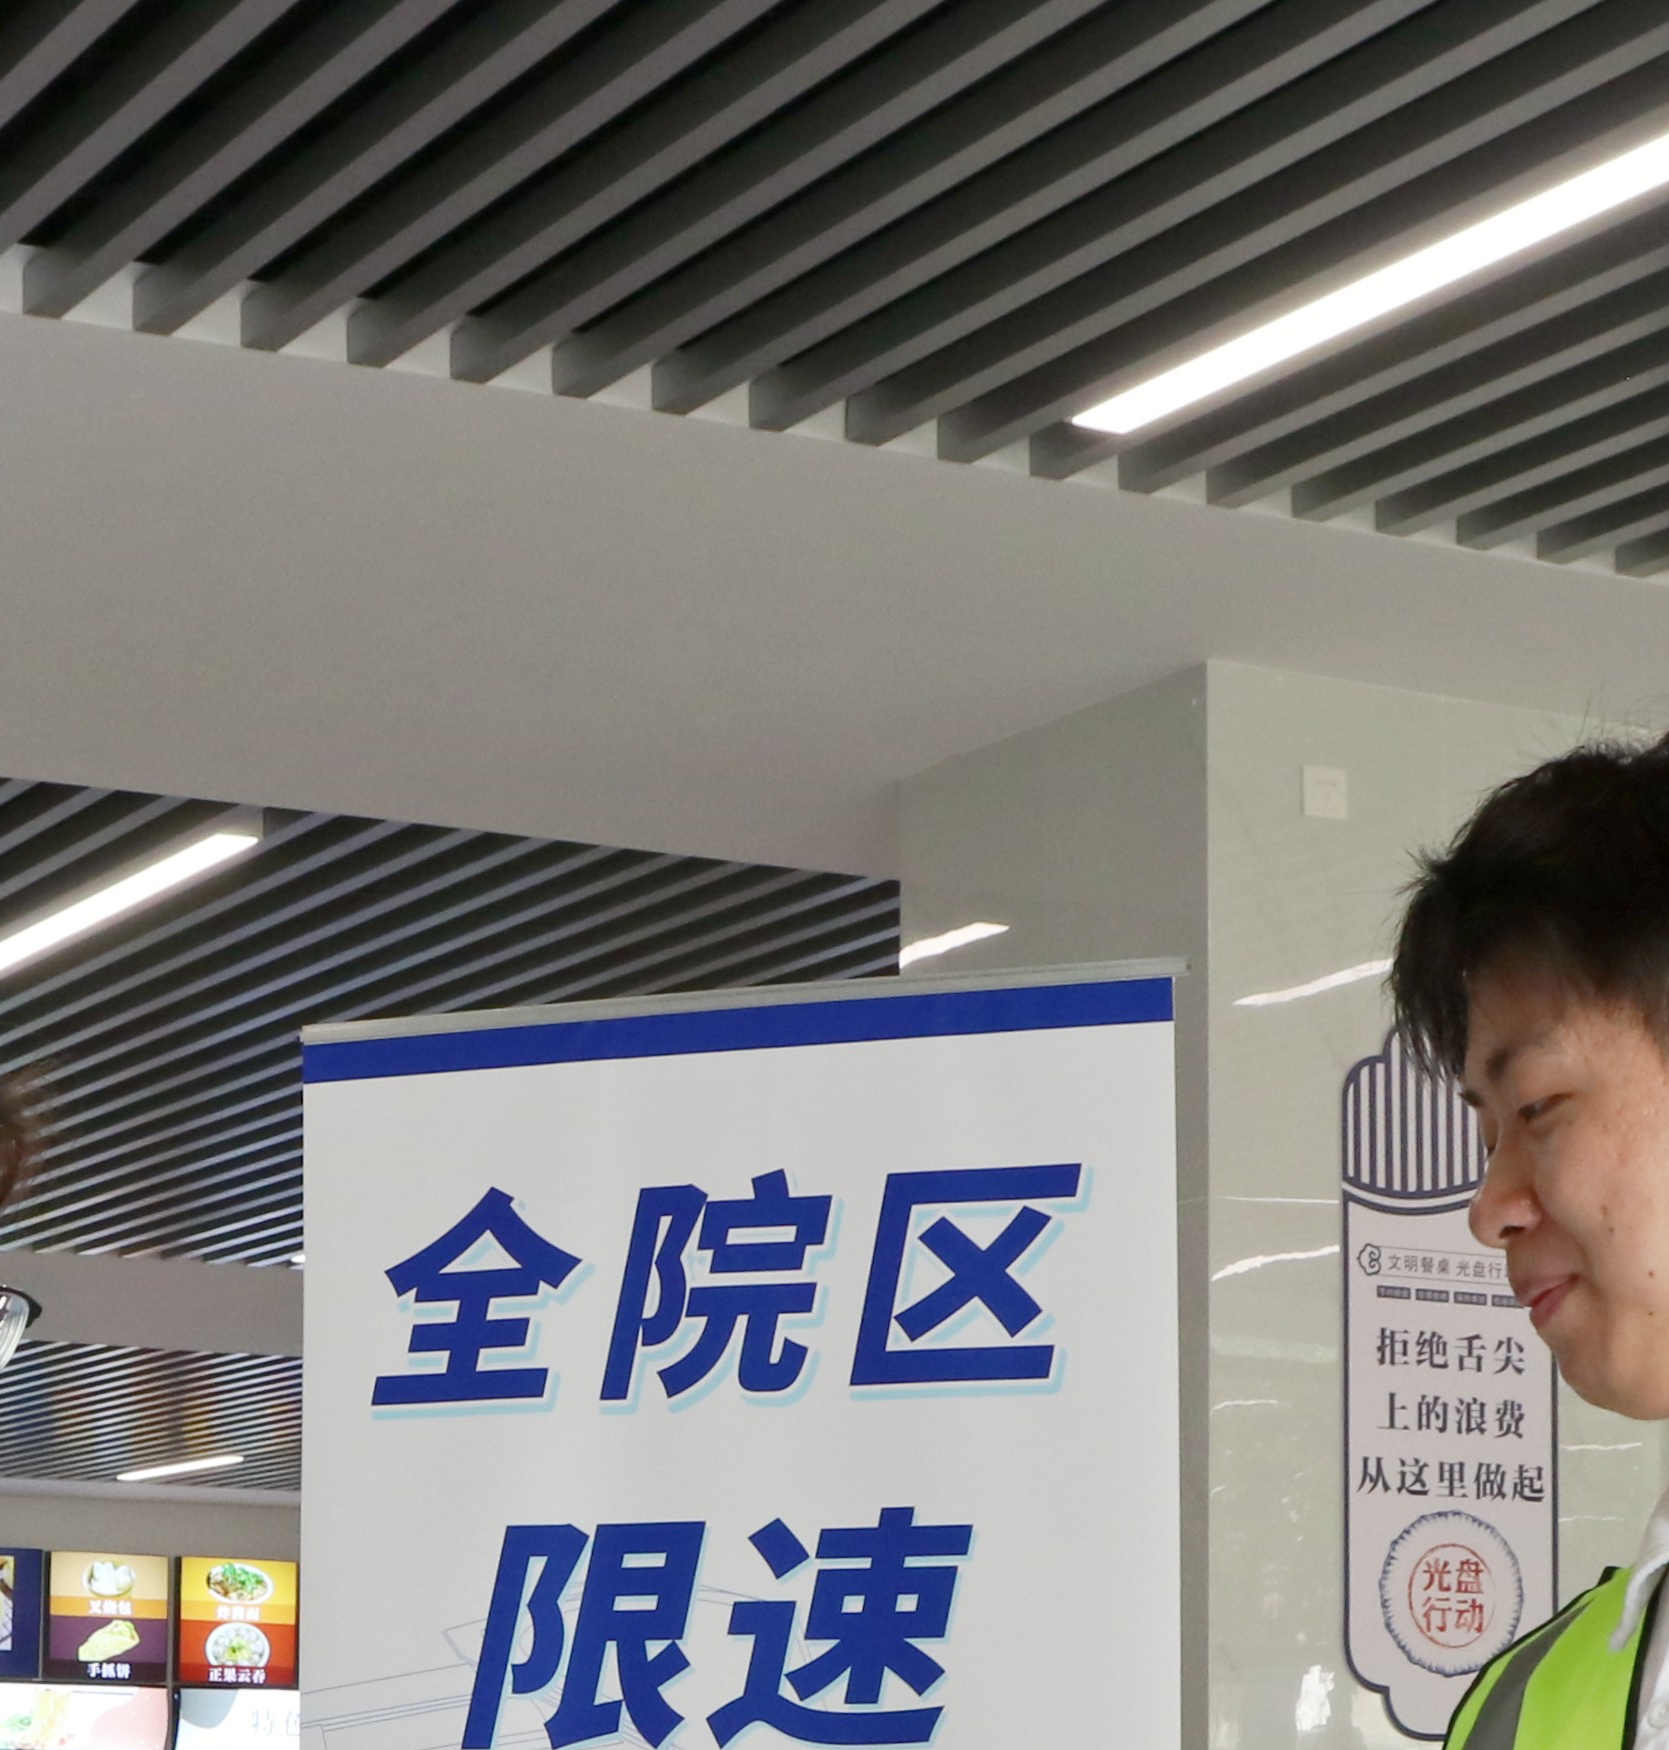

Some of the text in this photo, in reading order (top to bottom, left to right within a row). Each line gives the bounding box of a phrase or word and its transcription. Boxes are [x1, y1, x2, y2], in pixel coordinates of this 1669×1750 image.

[371, 1162, 1088, 1412] 全院区
[1388, 1254, 1507, 1280] 文明餐桌 光盘行
[1377, 1327, 1526, 1376] 拒绝舌尖
[1378, 1392, 1524, 1440] 上的浪费
[1356, 1456, 1545, 1503] 从这里做起
[1422, 1559, 1484, 1594] 光盘
[1422, 1597, 1484, 1634] 行动
[87, 1662, 132, 1680] 手抓饼
